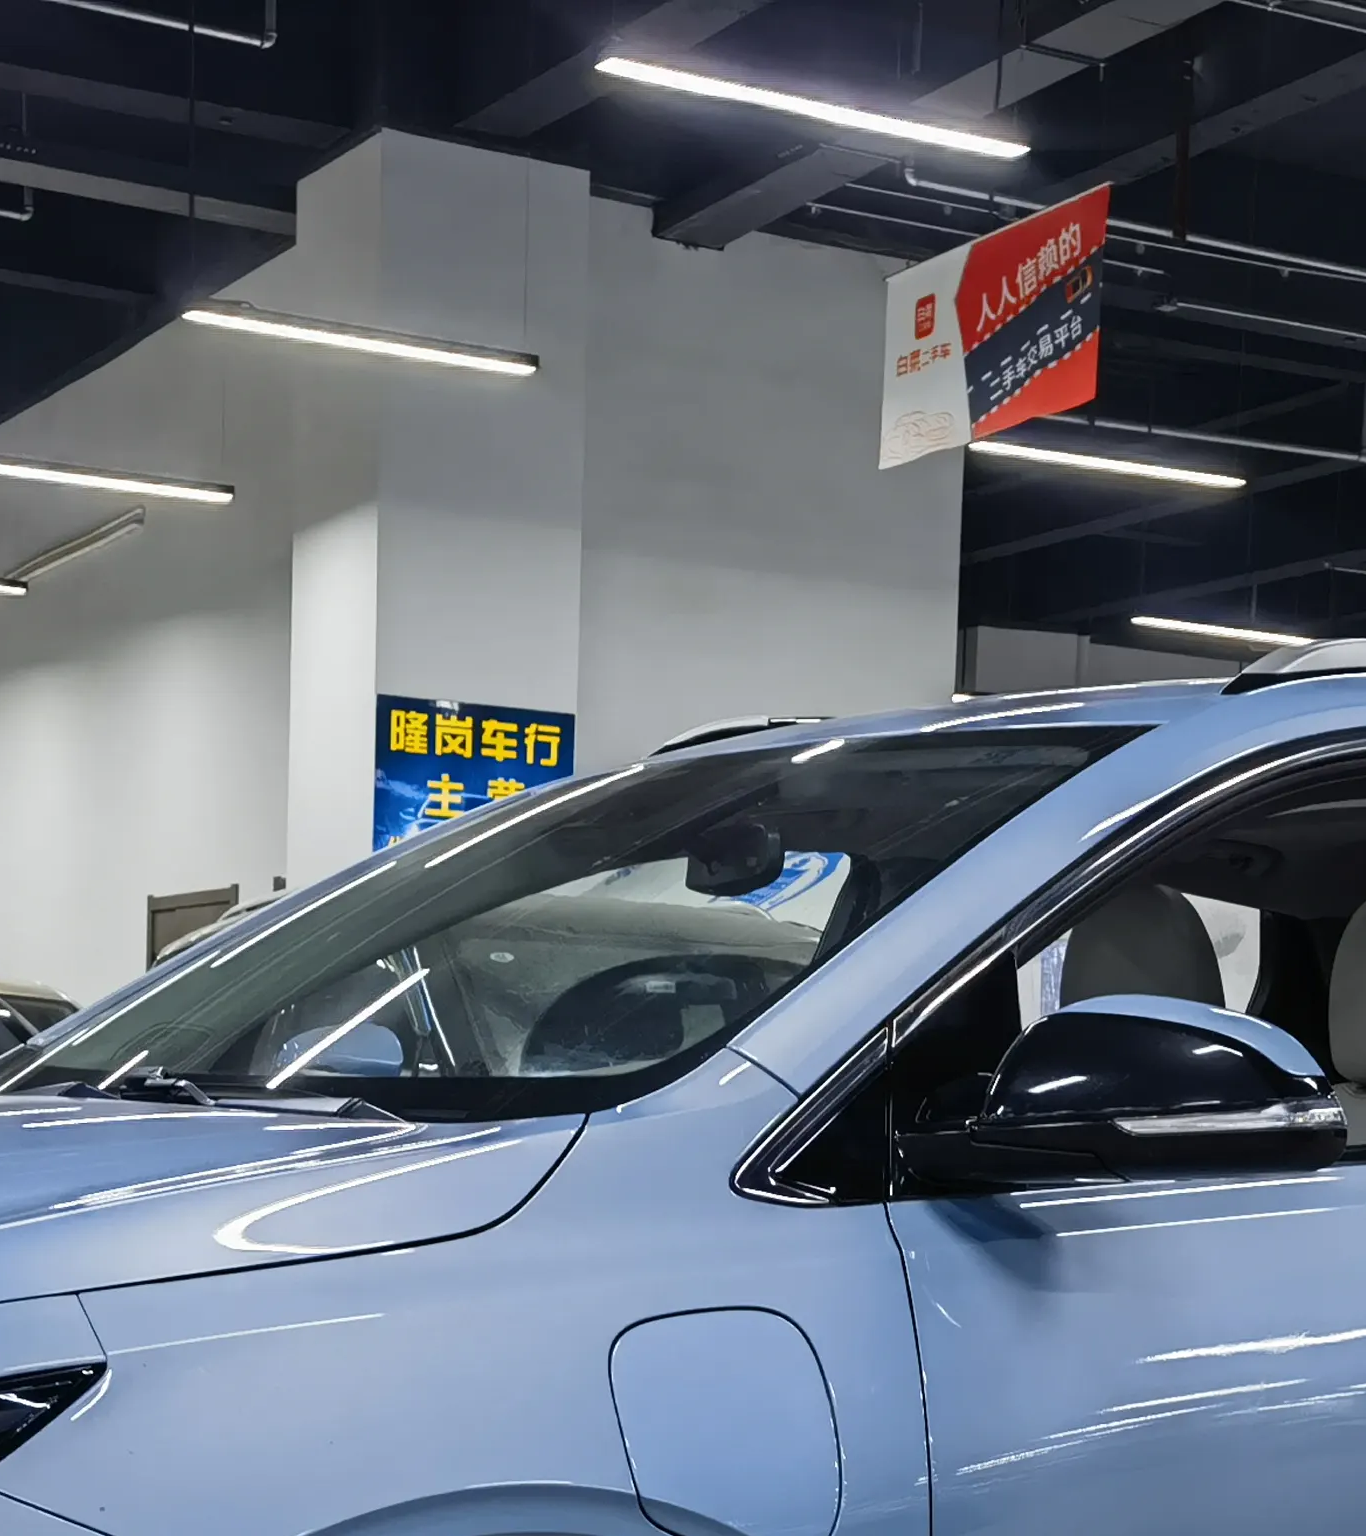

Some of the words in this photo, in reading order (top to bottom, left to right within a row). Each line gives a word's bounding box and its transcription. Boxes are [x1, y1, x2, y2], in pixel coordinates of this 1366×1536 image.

[975, 221, 1083, 333] 人人信赖的
[989, 314, 1084, 402] 二手车交易平台
[390, 709, 561, 767] 隆岗车行
